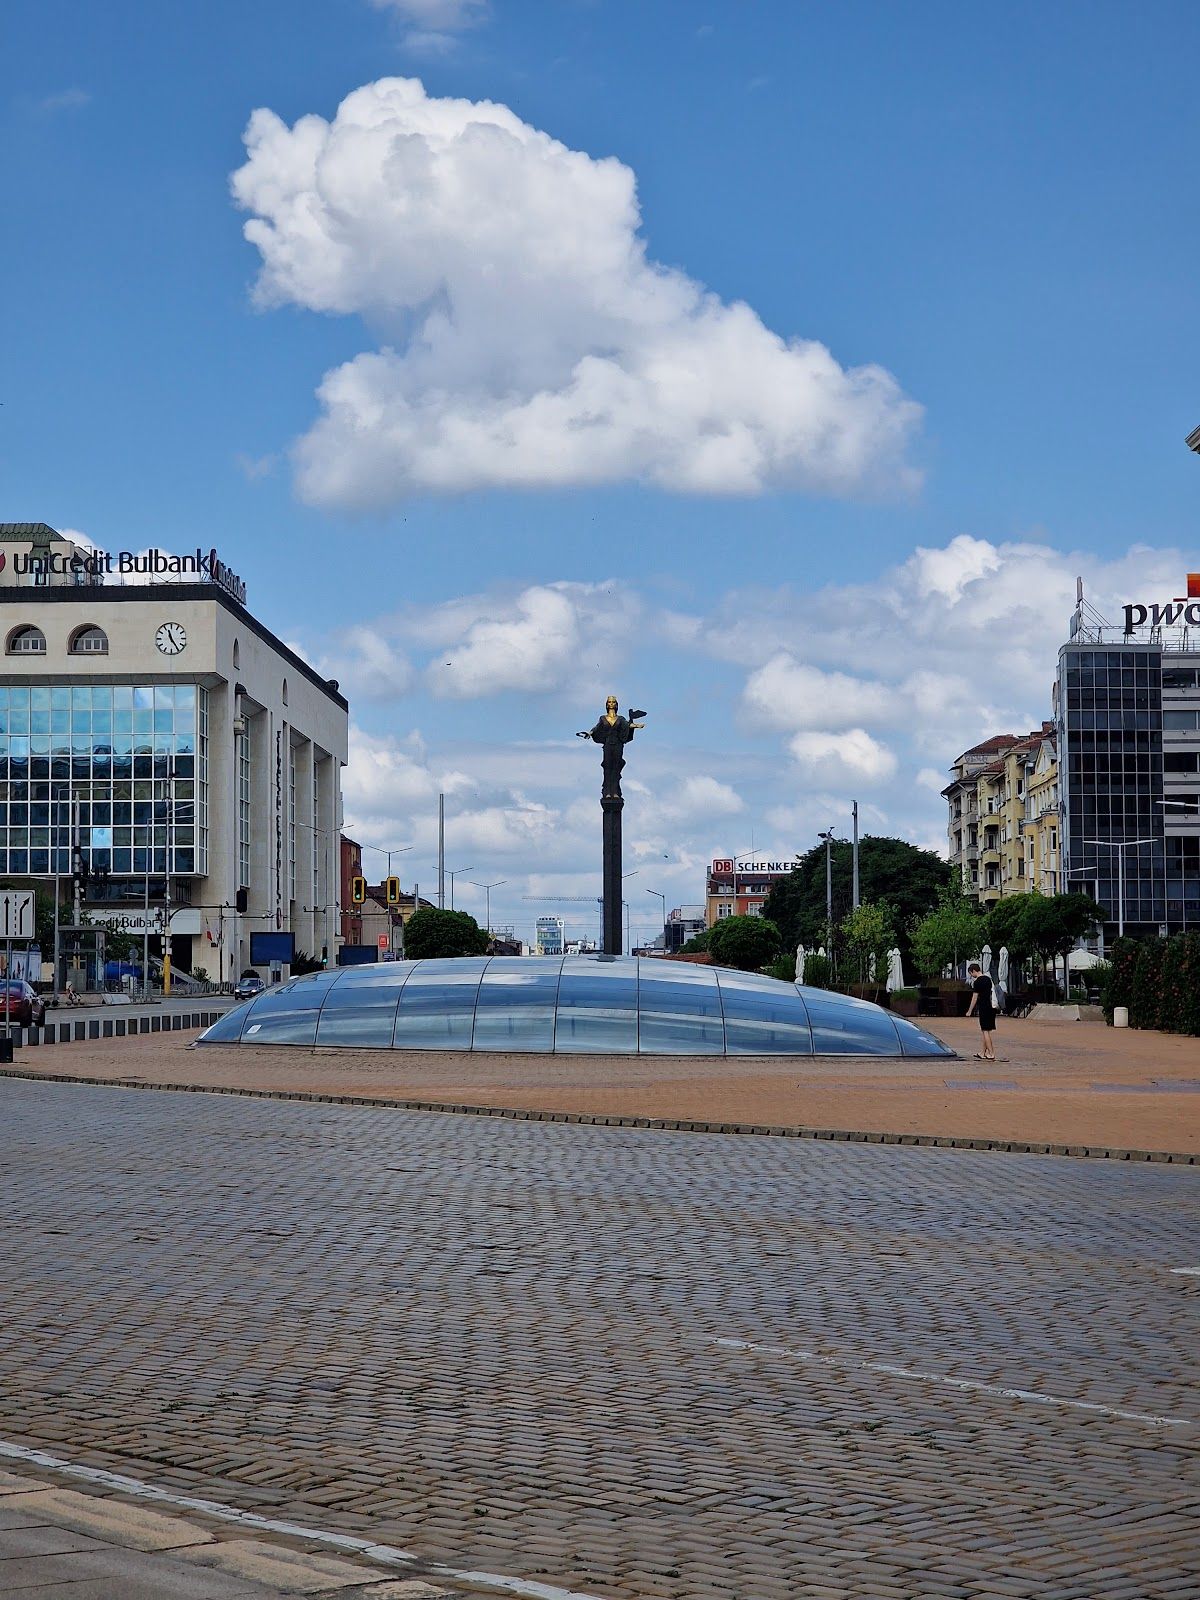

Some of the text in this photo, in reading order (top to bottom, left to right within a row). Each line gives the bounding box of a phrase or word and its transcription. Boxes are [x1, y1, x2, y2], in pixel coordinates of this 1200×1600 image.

[13, 548, 210, 575] UniCredit Bulbank
[1121, 603, 1200, 635] pwc
[715, 861, 732, 872] DB
